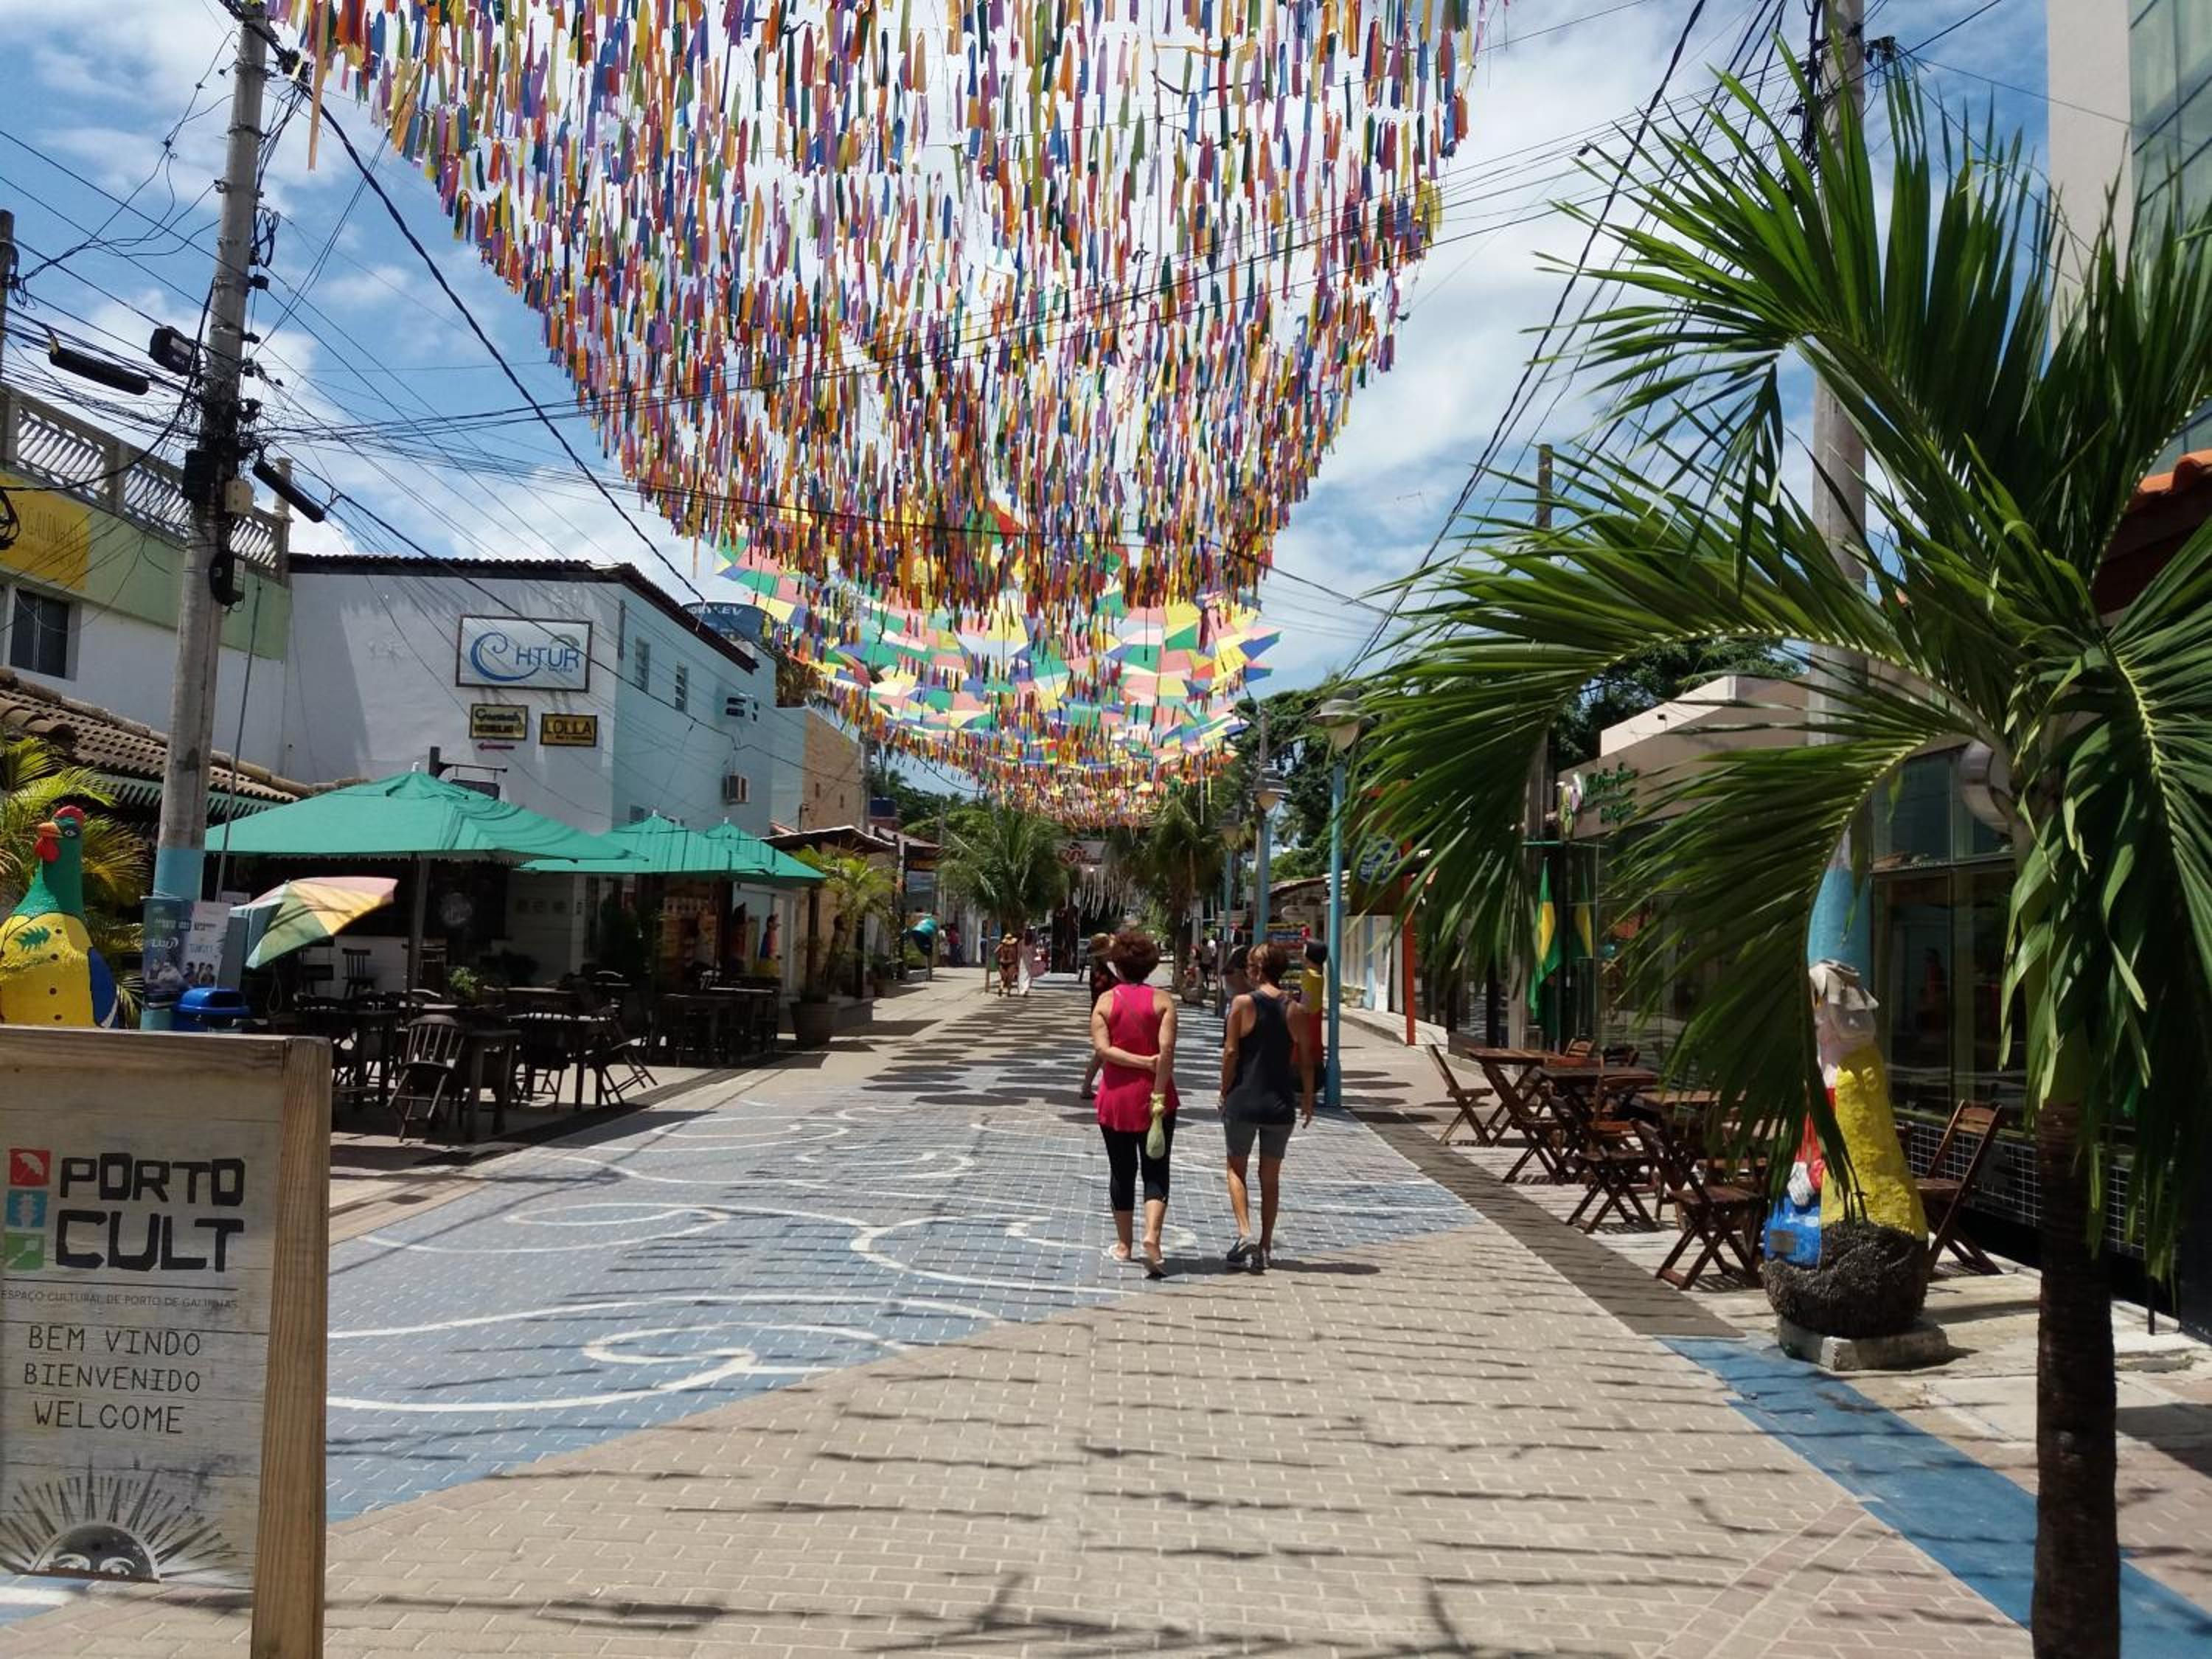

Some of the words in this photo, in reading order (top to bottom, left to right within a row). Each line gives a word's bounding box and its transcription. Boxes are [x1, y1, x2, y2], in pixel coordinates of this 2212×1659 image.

[545, 720, 592, 735] LOLLA
[60, 1152, 245, 1207] PORTO
[55, 1208, 244, 1273] CULT
[1, 1290, 44, 1303] ESPAÇO
[46, 1292, 100, 1304] CULTURAL
[106, 1294, 121, 1304] DE
[125, 1295, 161, 1307] PORTO
[164, 1297, 180, 1307] DE
[29, 1325, 85, 1352] BEM
[105, 1329, 201, 1356] VINDO
[24, 1363, 201, 1393] BIENVENIDO
[35, 1400, 184, 1434] WELCOME
